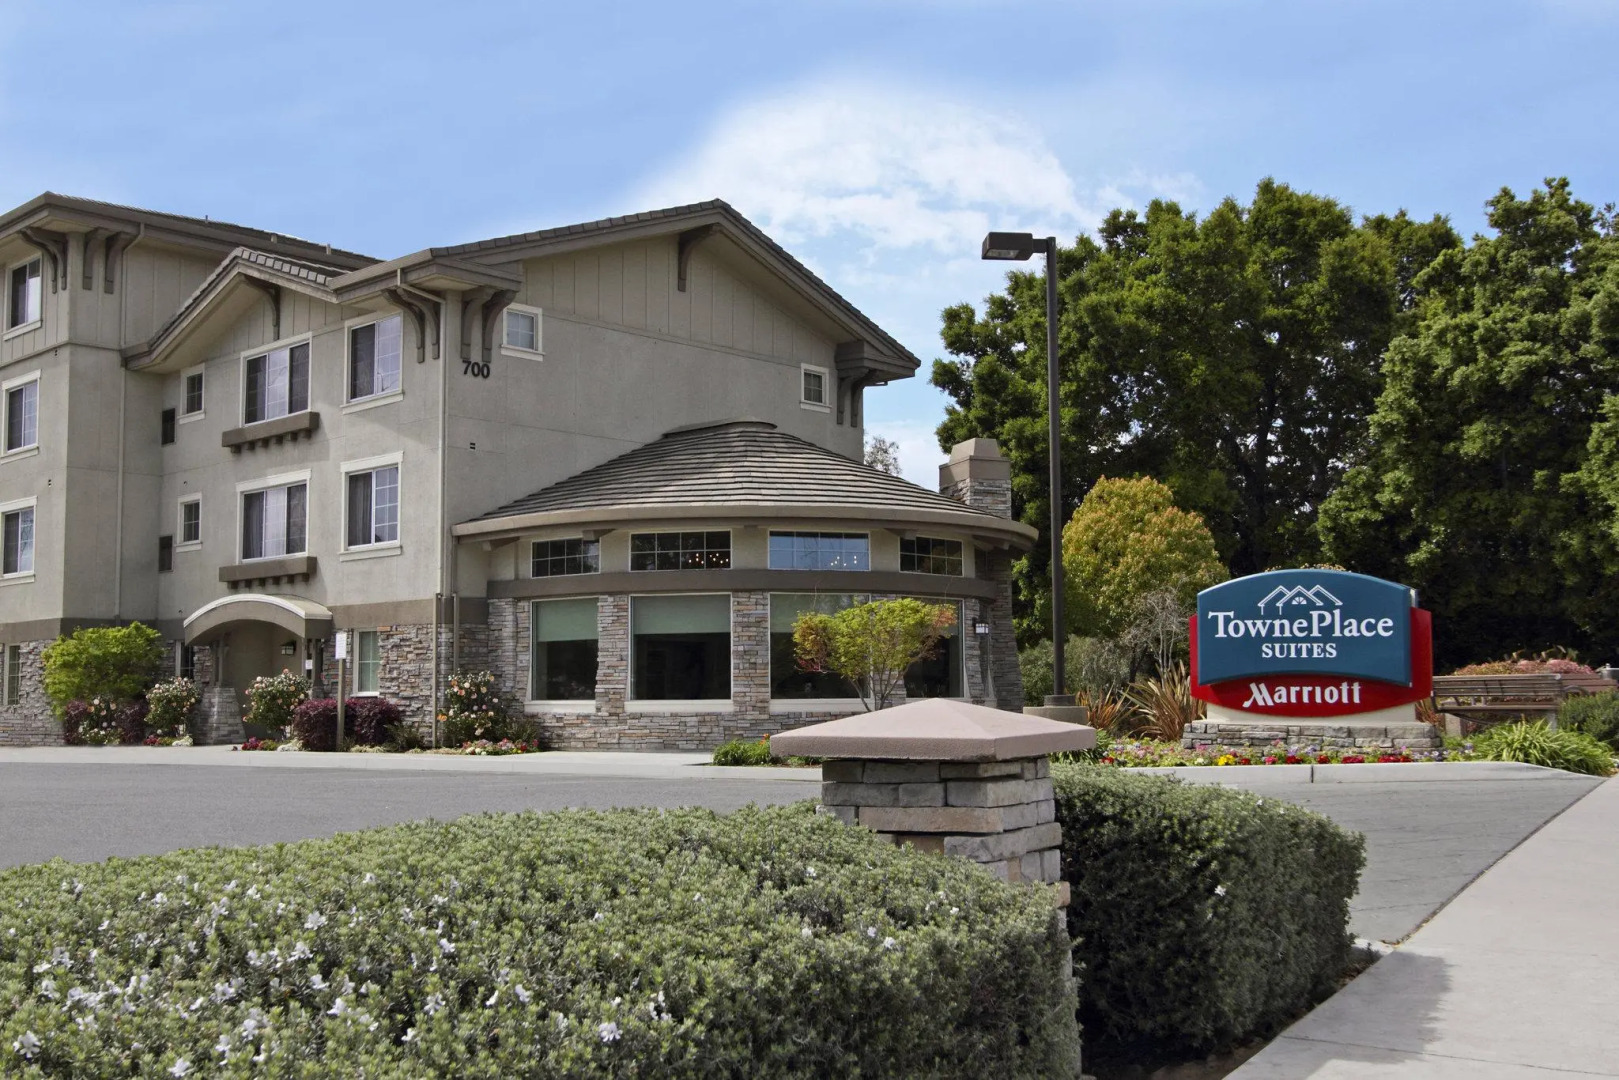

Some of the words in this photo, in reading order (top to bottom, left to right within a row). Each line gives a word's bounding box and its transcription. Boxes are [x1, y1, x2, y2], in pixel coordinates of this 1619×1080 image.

[462, 360, 490, 379] 700
[1208, 609, 1394, 638] TownePlace
[1261, 643, 1337, 658] SUITES
[1242, 682, 1361, 708] Marriott
